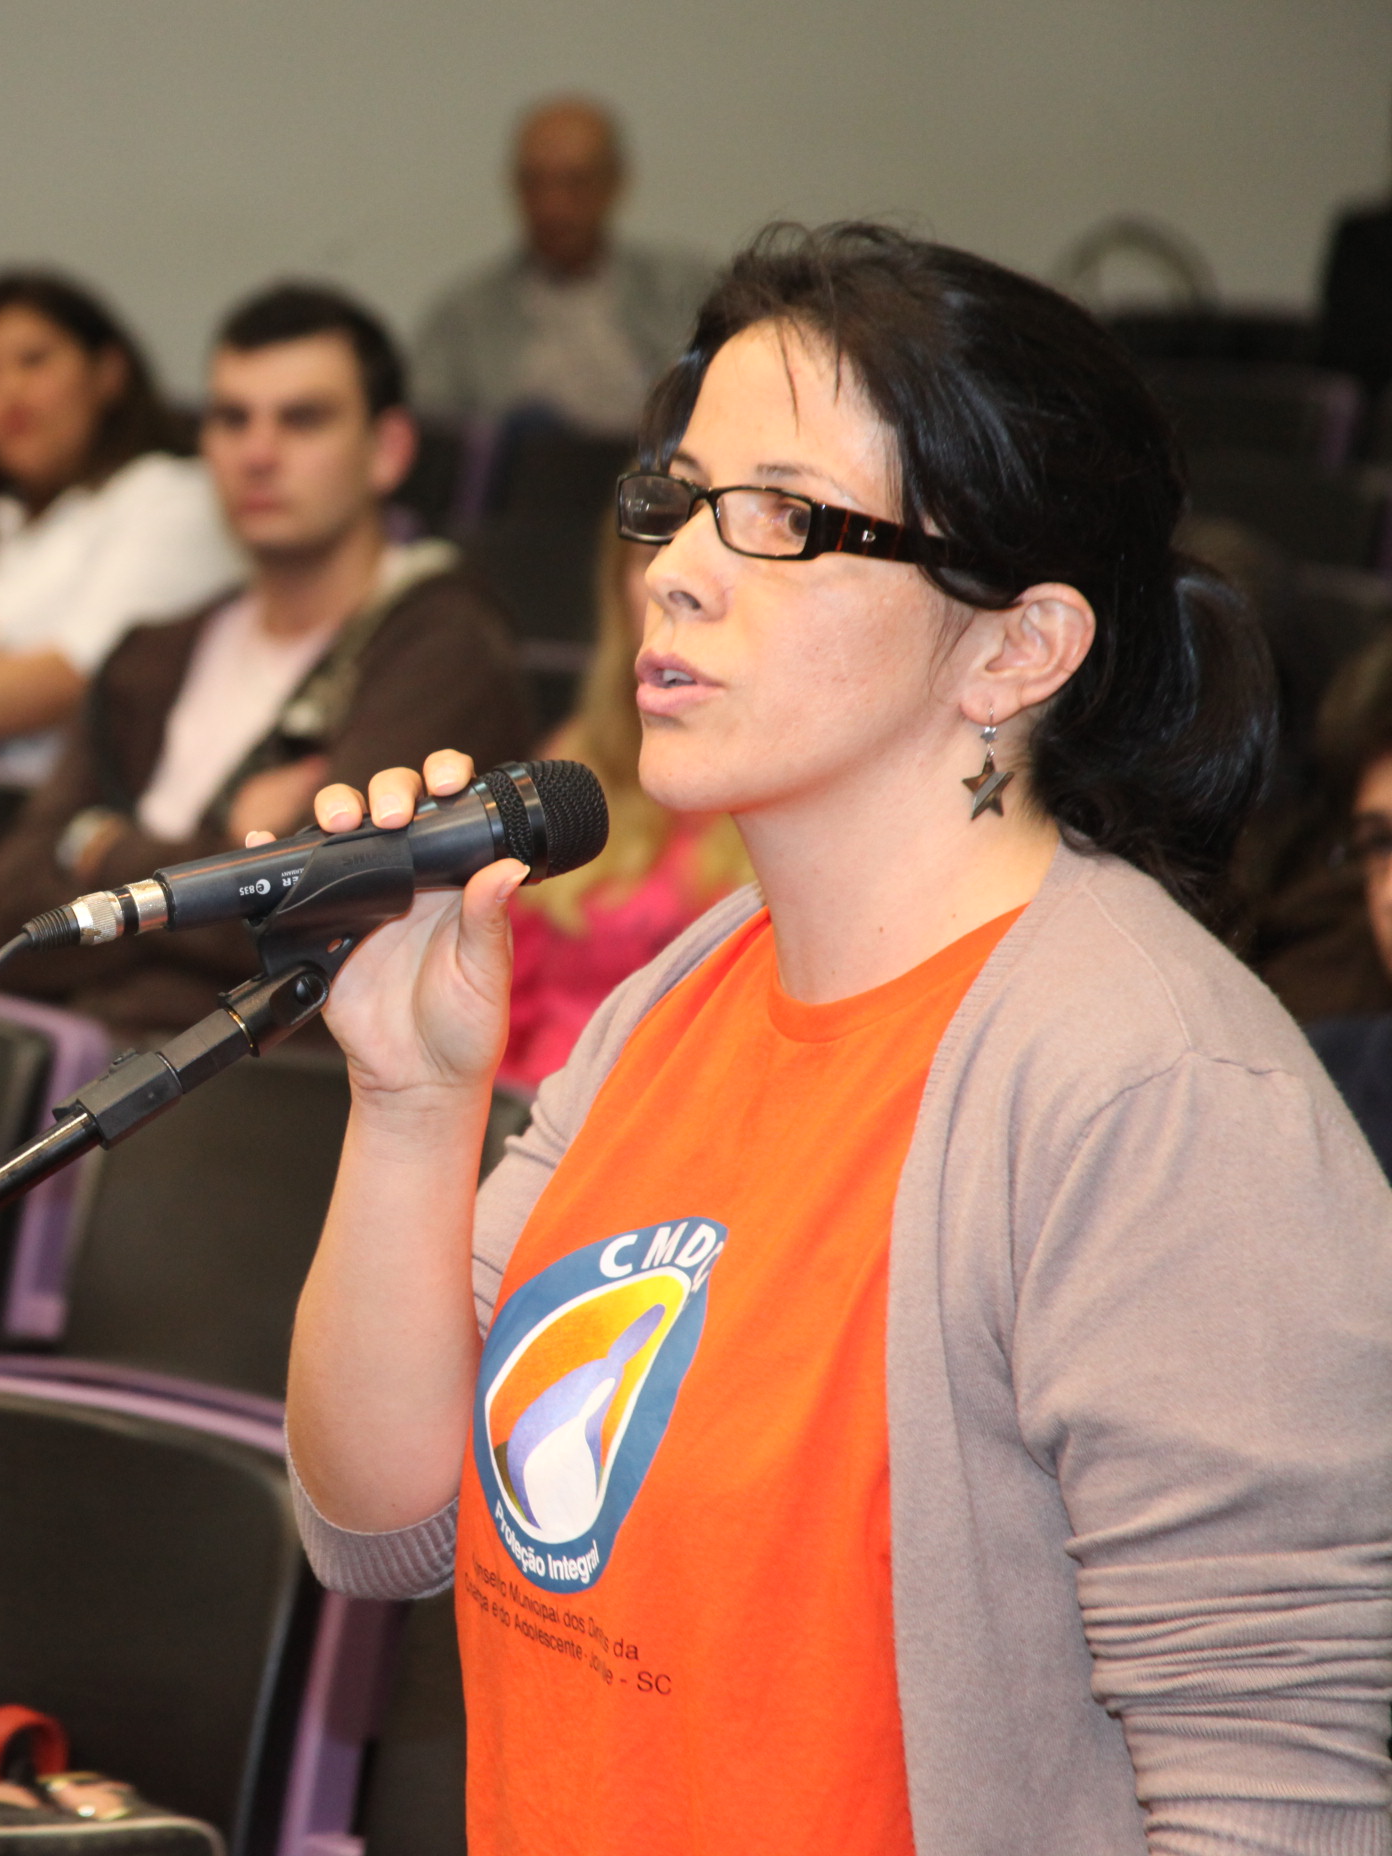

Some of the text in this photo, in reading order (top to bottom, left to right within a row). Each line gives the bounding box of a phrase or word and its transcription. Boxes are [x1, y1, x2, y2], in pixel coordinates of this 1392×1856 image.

[238, 884, 256, 896] 835
[494, 1498, 601, 1585] Proteção Integral
[509, 1581, 561, 1623] Municipal
[562, 1608, 586, 1634] dos
[612, 1637, 639, 1661] da
[513, 1612, 584, 1661] Adolescente
[636, 1669, 672, 1695] SC
